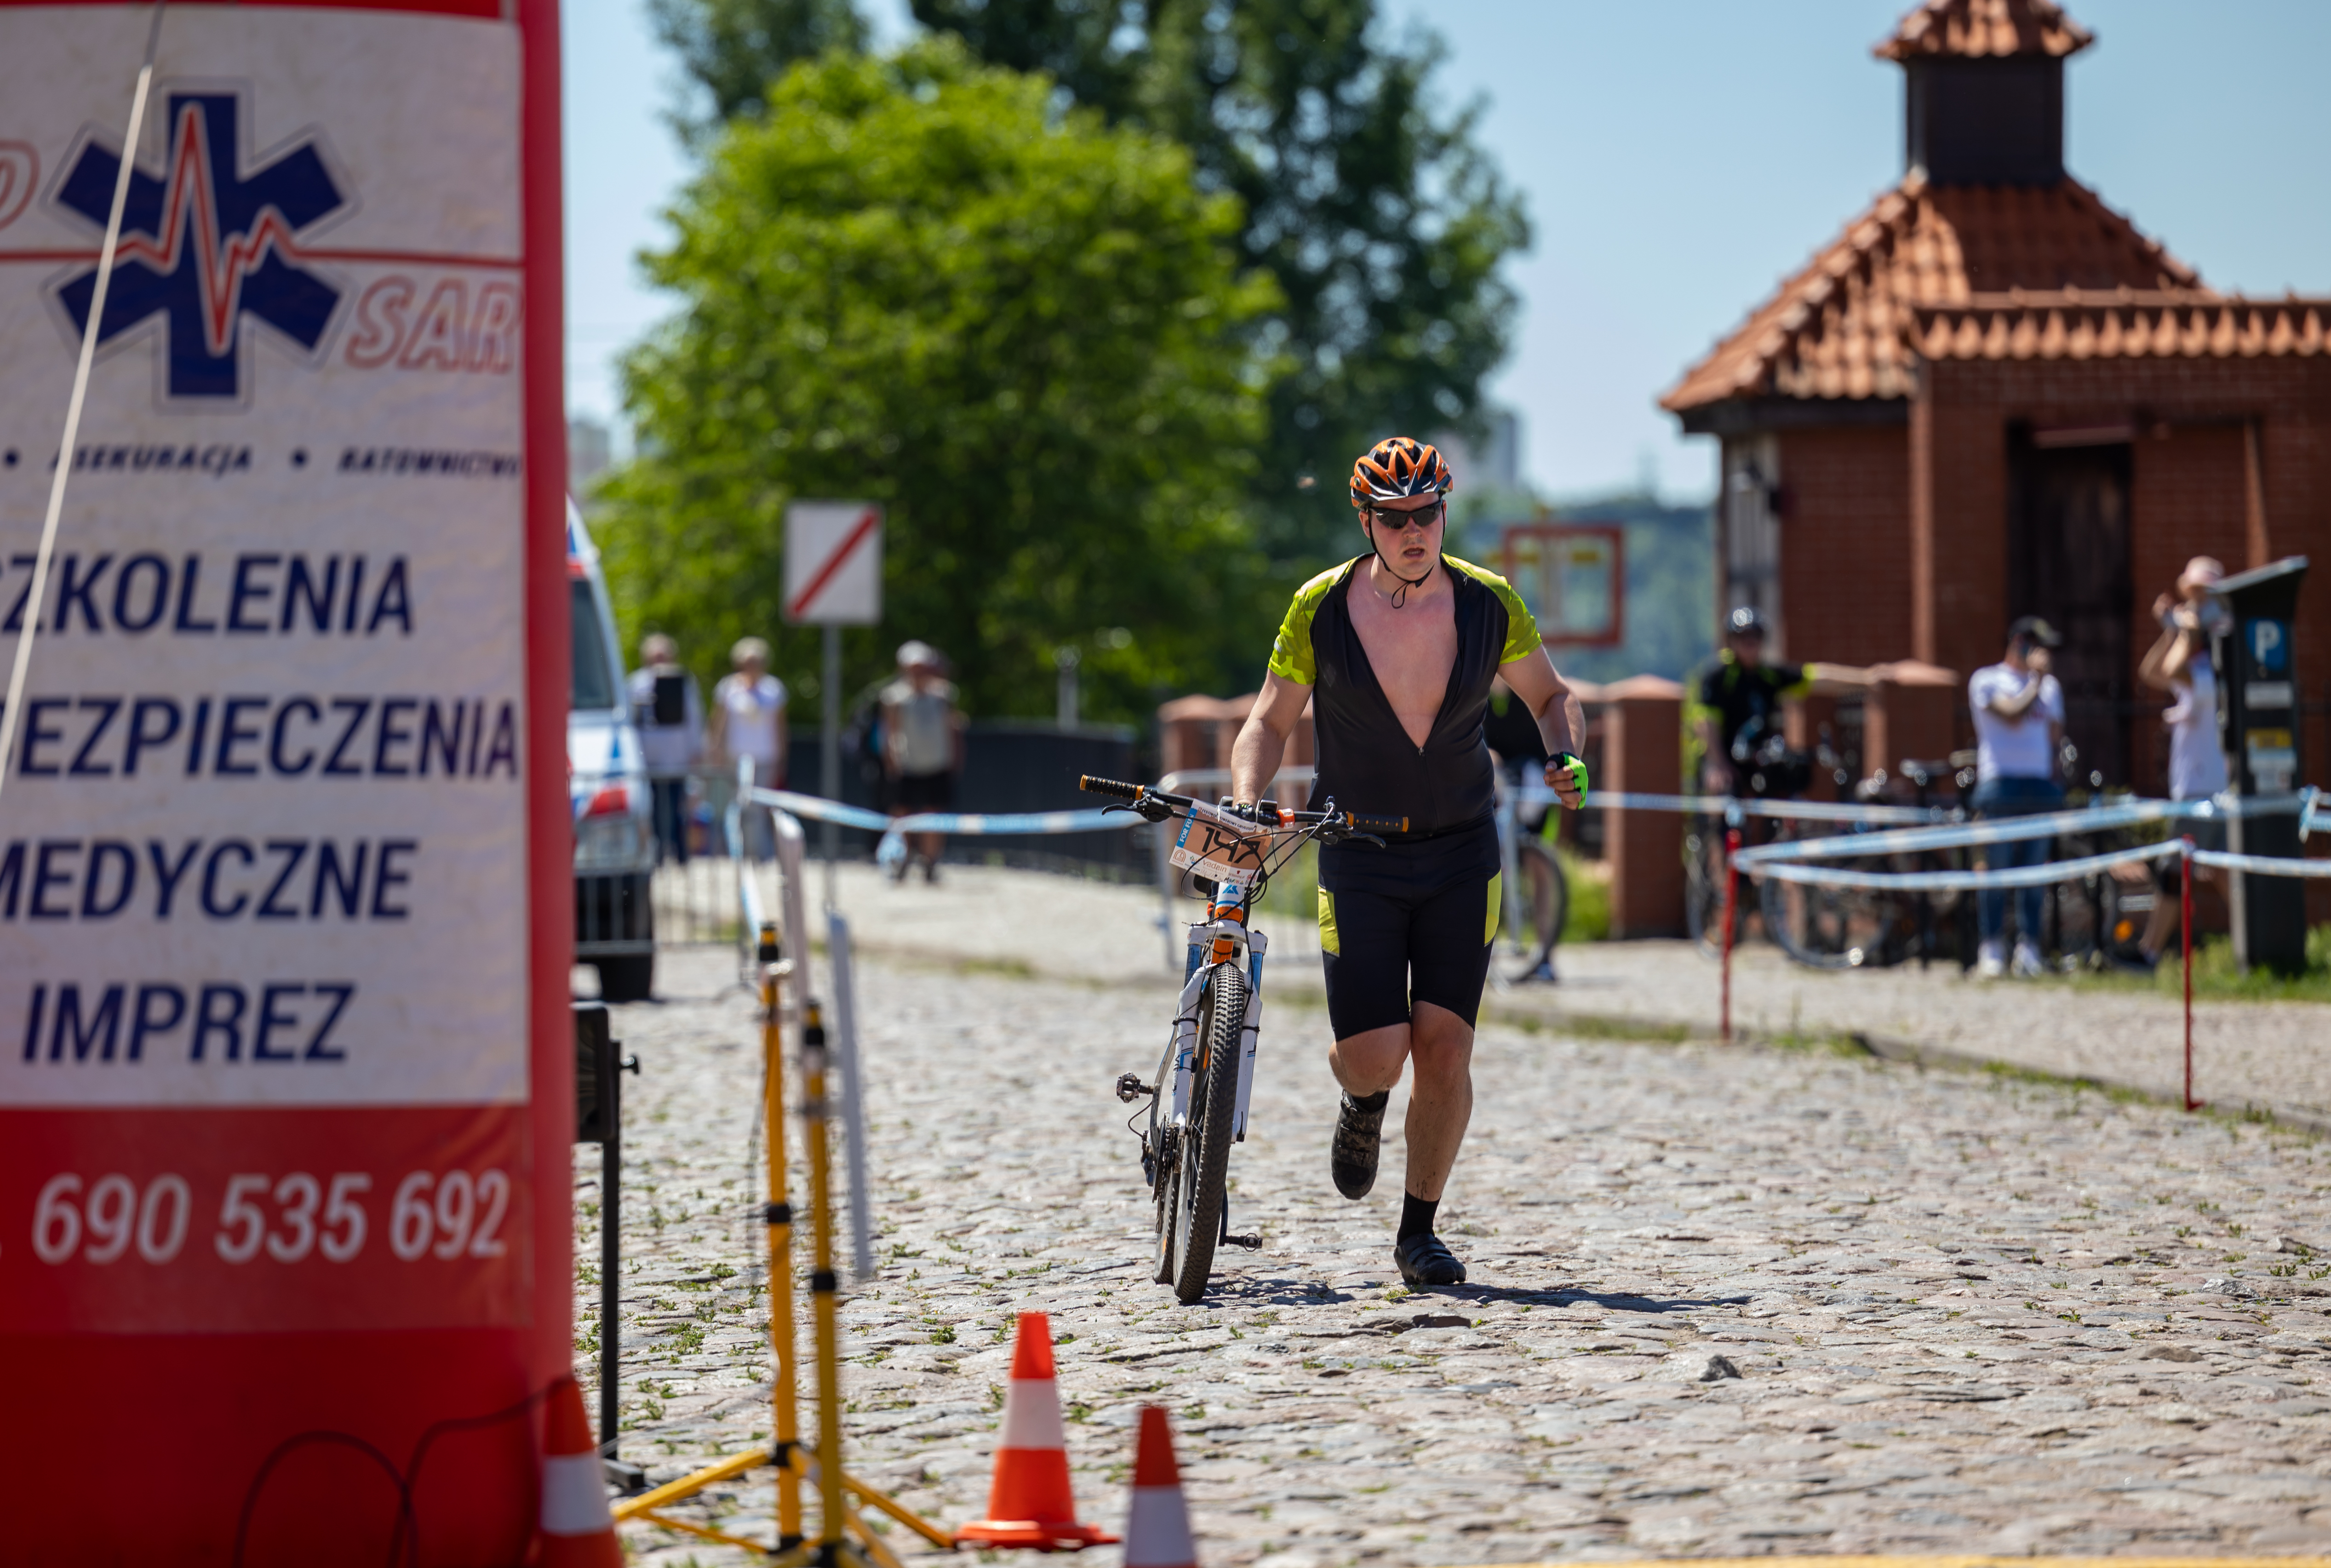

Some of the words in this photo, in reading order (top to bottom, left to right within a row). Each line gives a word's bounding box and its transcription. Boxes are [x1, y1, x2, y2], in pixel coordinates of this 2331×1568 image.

[344, 274, 523, 372] SAR
[0, 553, 414, 635] ZKOLENIA
[0, 696, 520, 780] EZPIECZENIA
[1180, 828, 1189, 842] FOR
[1185, 813, 1194, 828] FUN
[1202, 826, 1261, 864] 147
[1220, 816, 1237, 826] OWEROWY
[22, 980, 357, 1064] IMPREZ
[31, 1172, 192, 1265] 690
[213, 1172, 373, 1264] 535
[389, 1168, 510, 1262] 692
